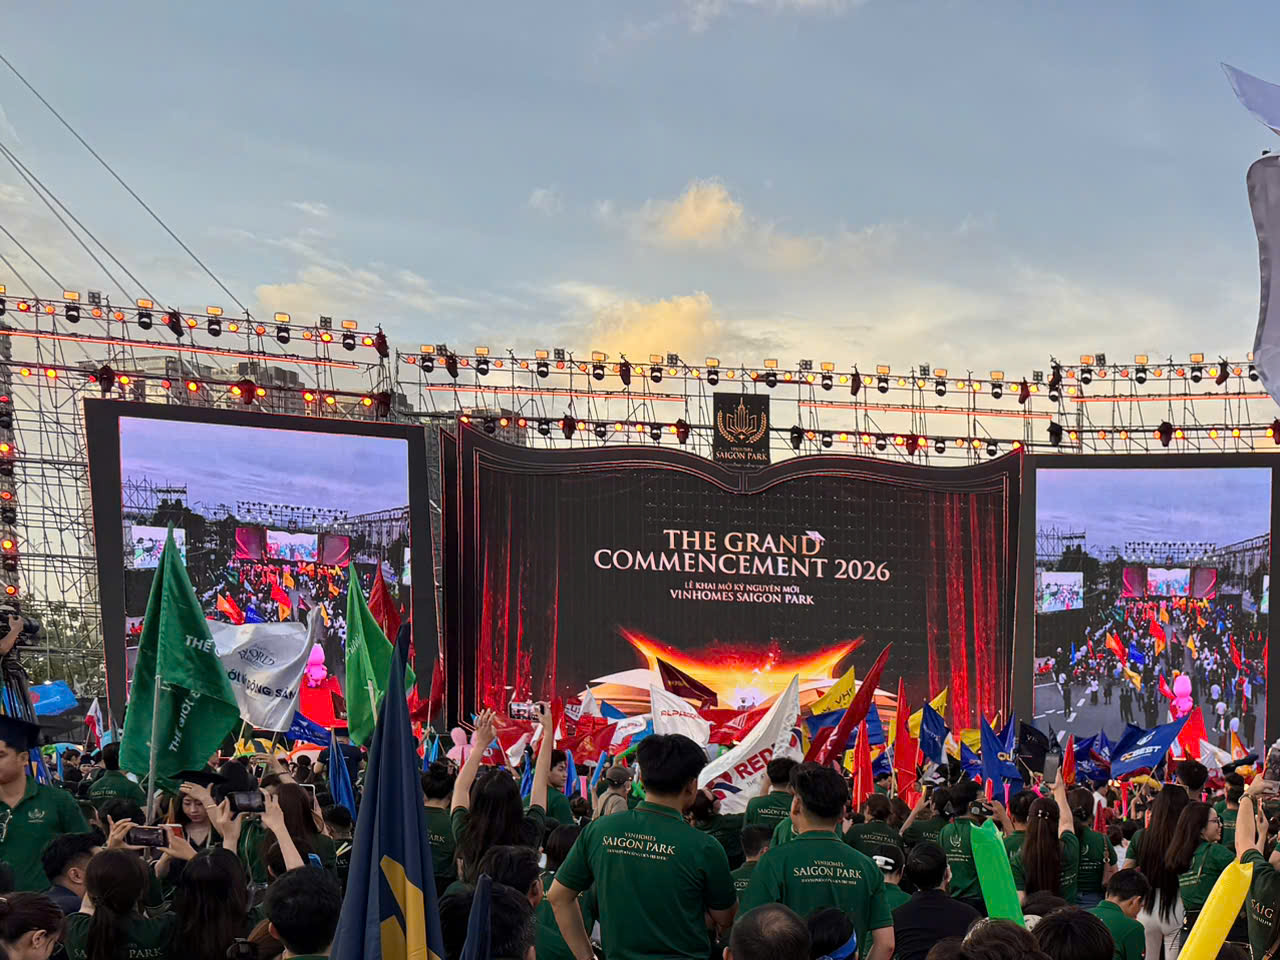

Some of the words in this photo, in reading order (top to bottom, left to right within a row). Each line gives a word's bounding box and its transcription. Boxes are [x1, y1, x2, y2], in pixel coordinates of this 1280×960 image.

[664, 529, 717, 551] THE
[724, 532, 822, 556] GRAND
[594, 549, 827, 579] COMMENCEMENT
[834, 558, 890, 581] 2026
[670, 589, 734, 602] VINHOMES
[736, 591, 782, 604] SAIGON
[785, 594, 815, 606] PARK
[602, 835, 644, 850] SAIGON
[646, 841, 675, 855] PARK
[793, 866, 834, 877] SAIGON
[837, 867, 862, 879] PARK
[1251, 898, 1274, 919] SAIG
